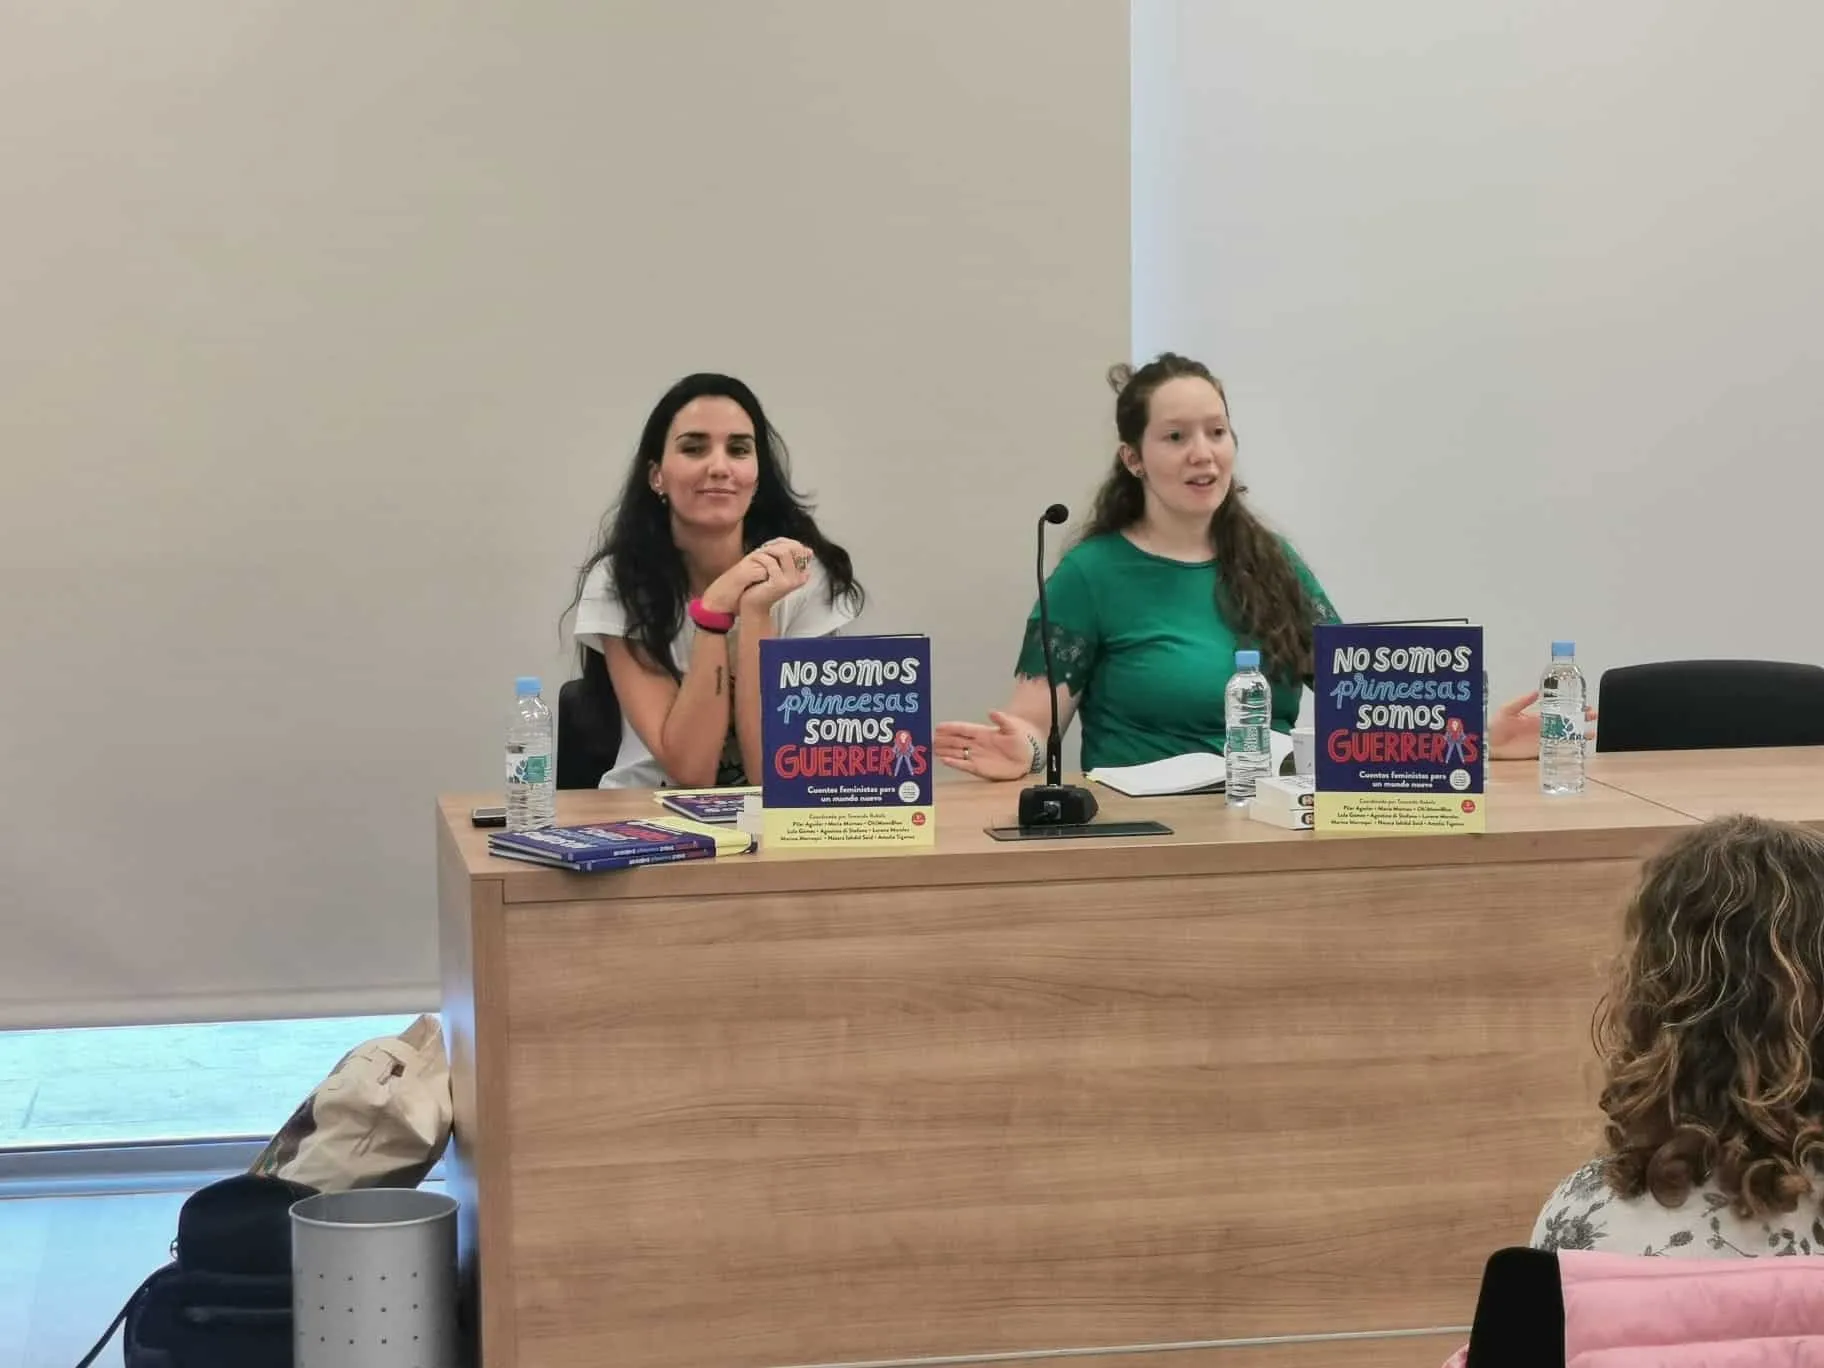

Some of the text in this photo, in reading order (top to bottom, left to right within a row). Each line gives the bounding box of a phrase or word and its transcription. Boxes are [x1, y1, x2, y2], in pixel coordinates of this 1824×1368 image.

[1333, 647, 1370, 674] NO
[779, 660, 817, 689] NO
[1330, 673, 1471, 710] princesas
[777, 687, 919, 724] princesas
[1358, 770, 1389, 779] Cuentos
[1390, 771, 1429, 780] feministas
[1430, 773, 1447, 782] para
[1383, 779, 1410, 788] mundo
[807, 785, 838, 794] Cuentos
[839, 784, 878, 793] feministas
[879, 786, 896, 795] para
[832, 794, 859, 802] mundo
